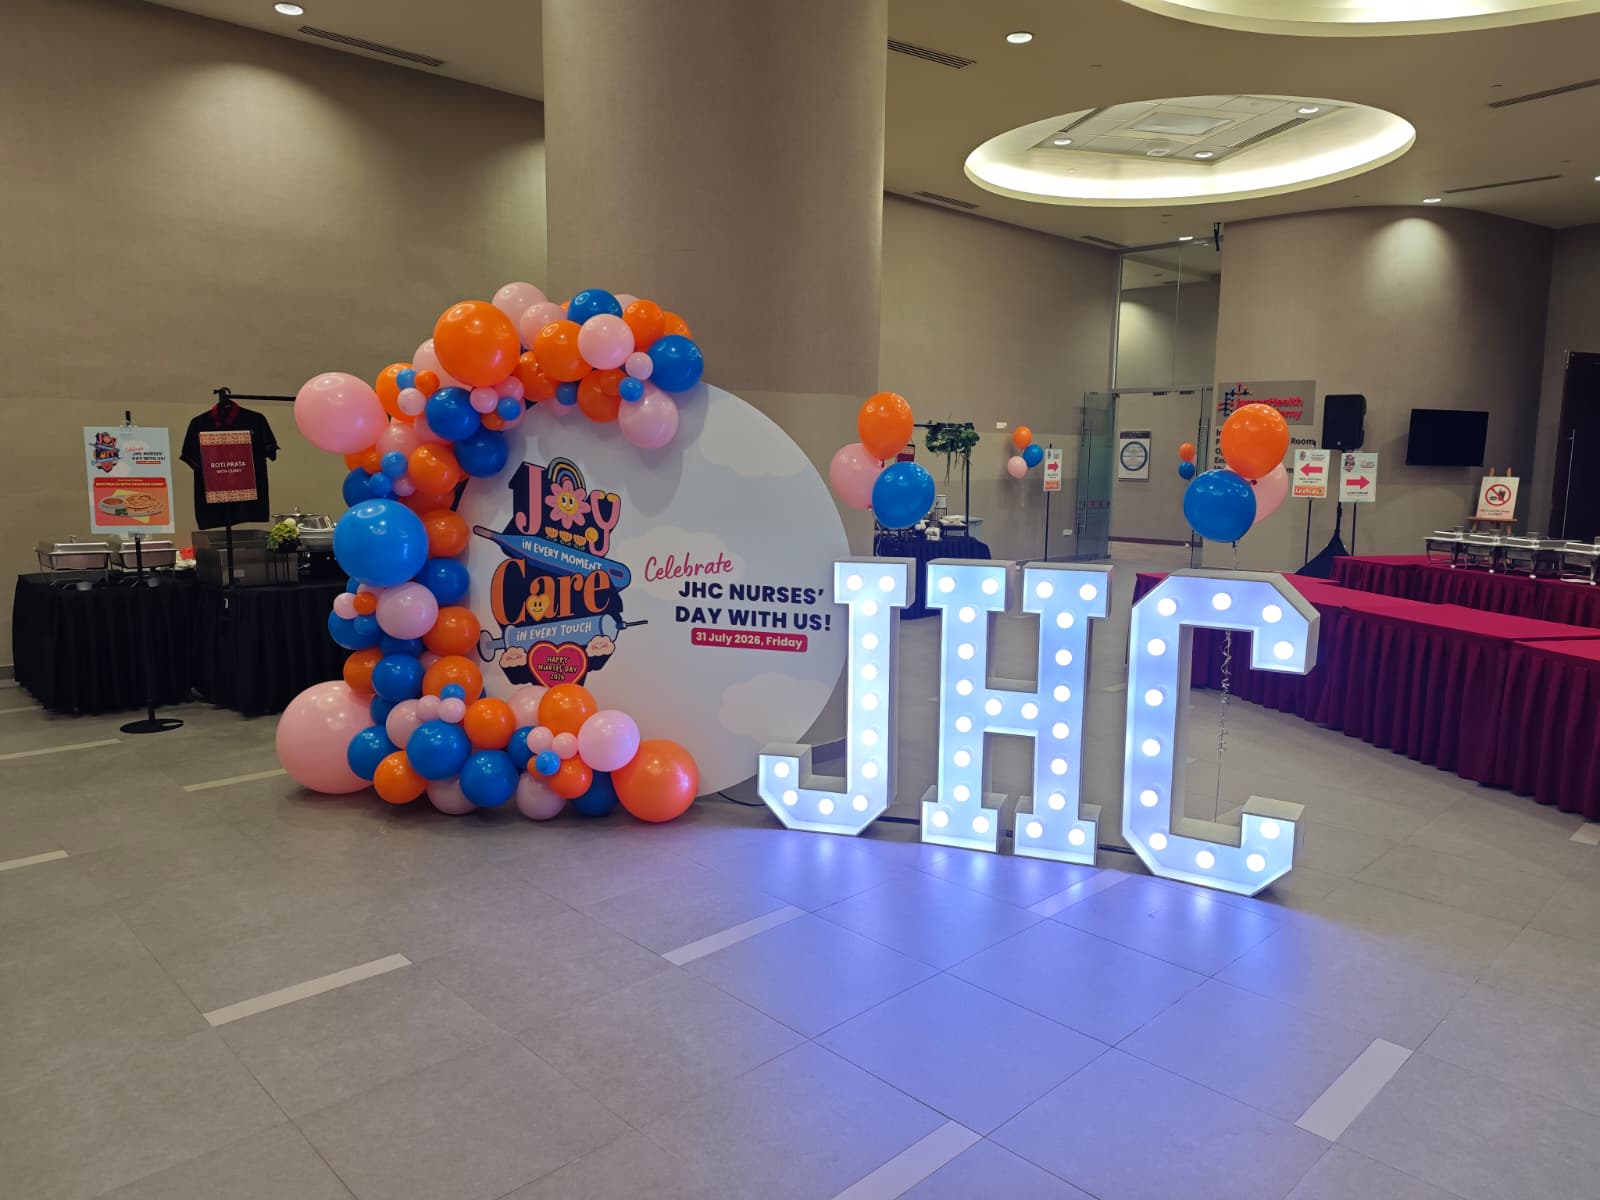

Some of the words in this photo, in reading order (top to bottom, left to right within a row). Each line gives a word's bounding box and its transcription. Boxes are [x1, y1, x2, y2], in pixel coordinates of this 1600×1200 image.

[533, 543, 559, 560] EVERY
[560, 551, 602, 571] MOMENT
[644, 552, 734, 582] Celebrate
[490, 558, 611, 626] Care
[678, 581, 723, 599] JHC
[529, 625, 557, 640] EVERY
[561, 621, 592, 637] TOUCH
[675, 606, 722, 625] DAY
[728, 608, 787, 629] WITH
[793, 612, 831, 632] US!
[696, 631, 707, 641] 31
[709, 632, 733, 646] July
[734, 634, 764, 646] 2026,
[766, 636, 802, 650] Friday
[758, 556, 1321, 898] JHC
